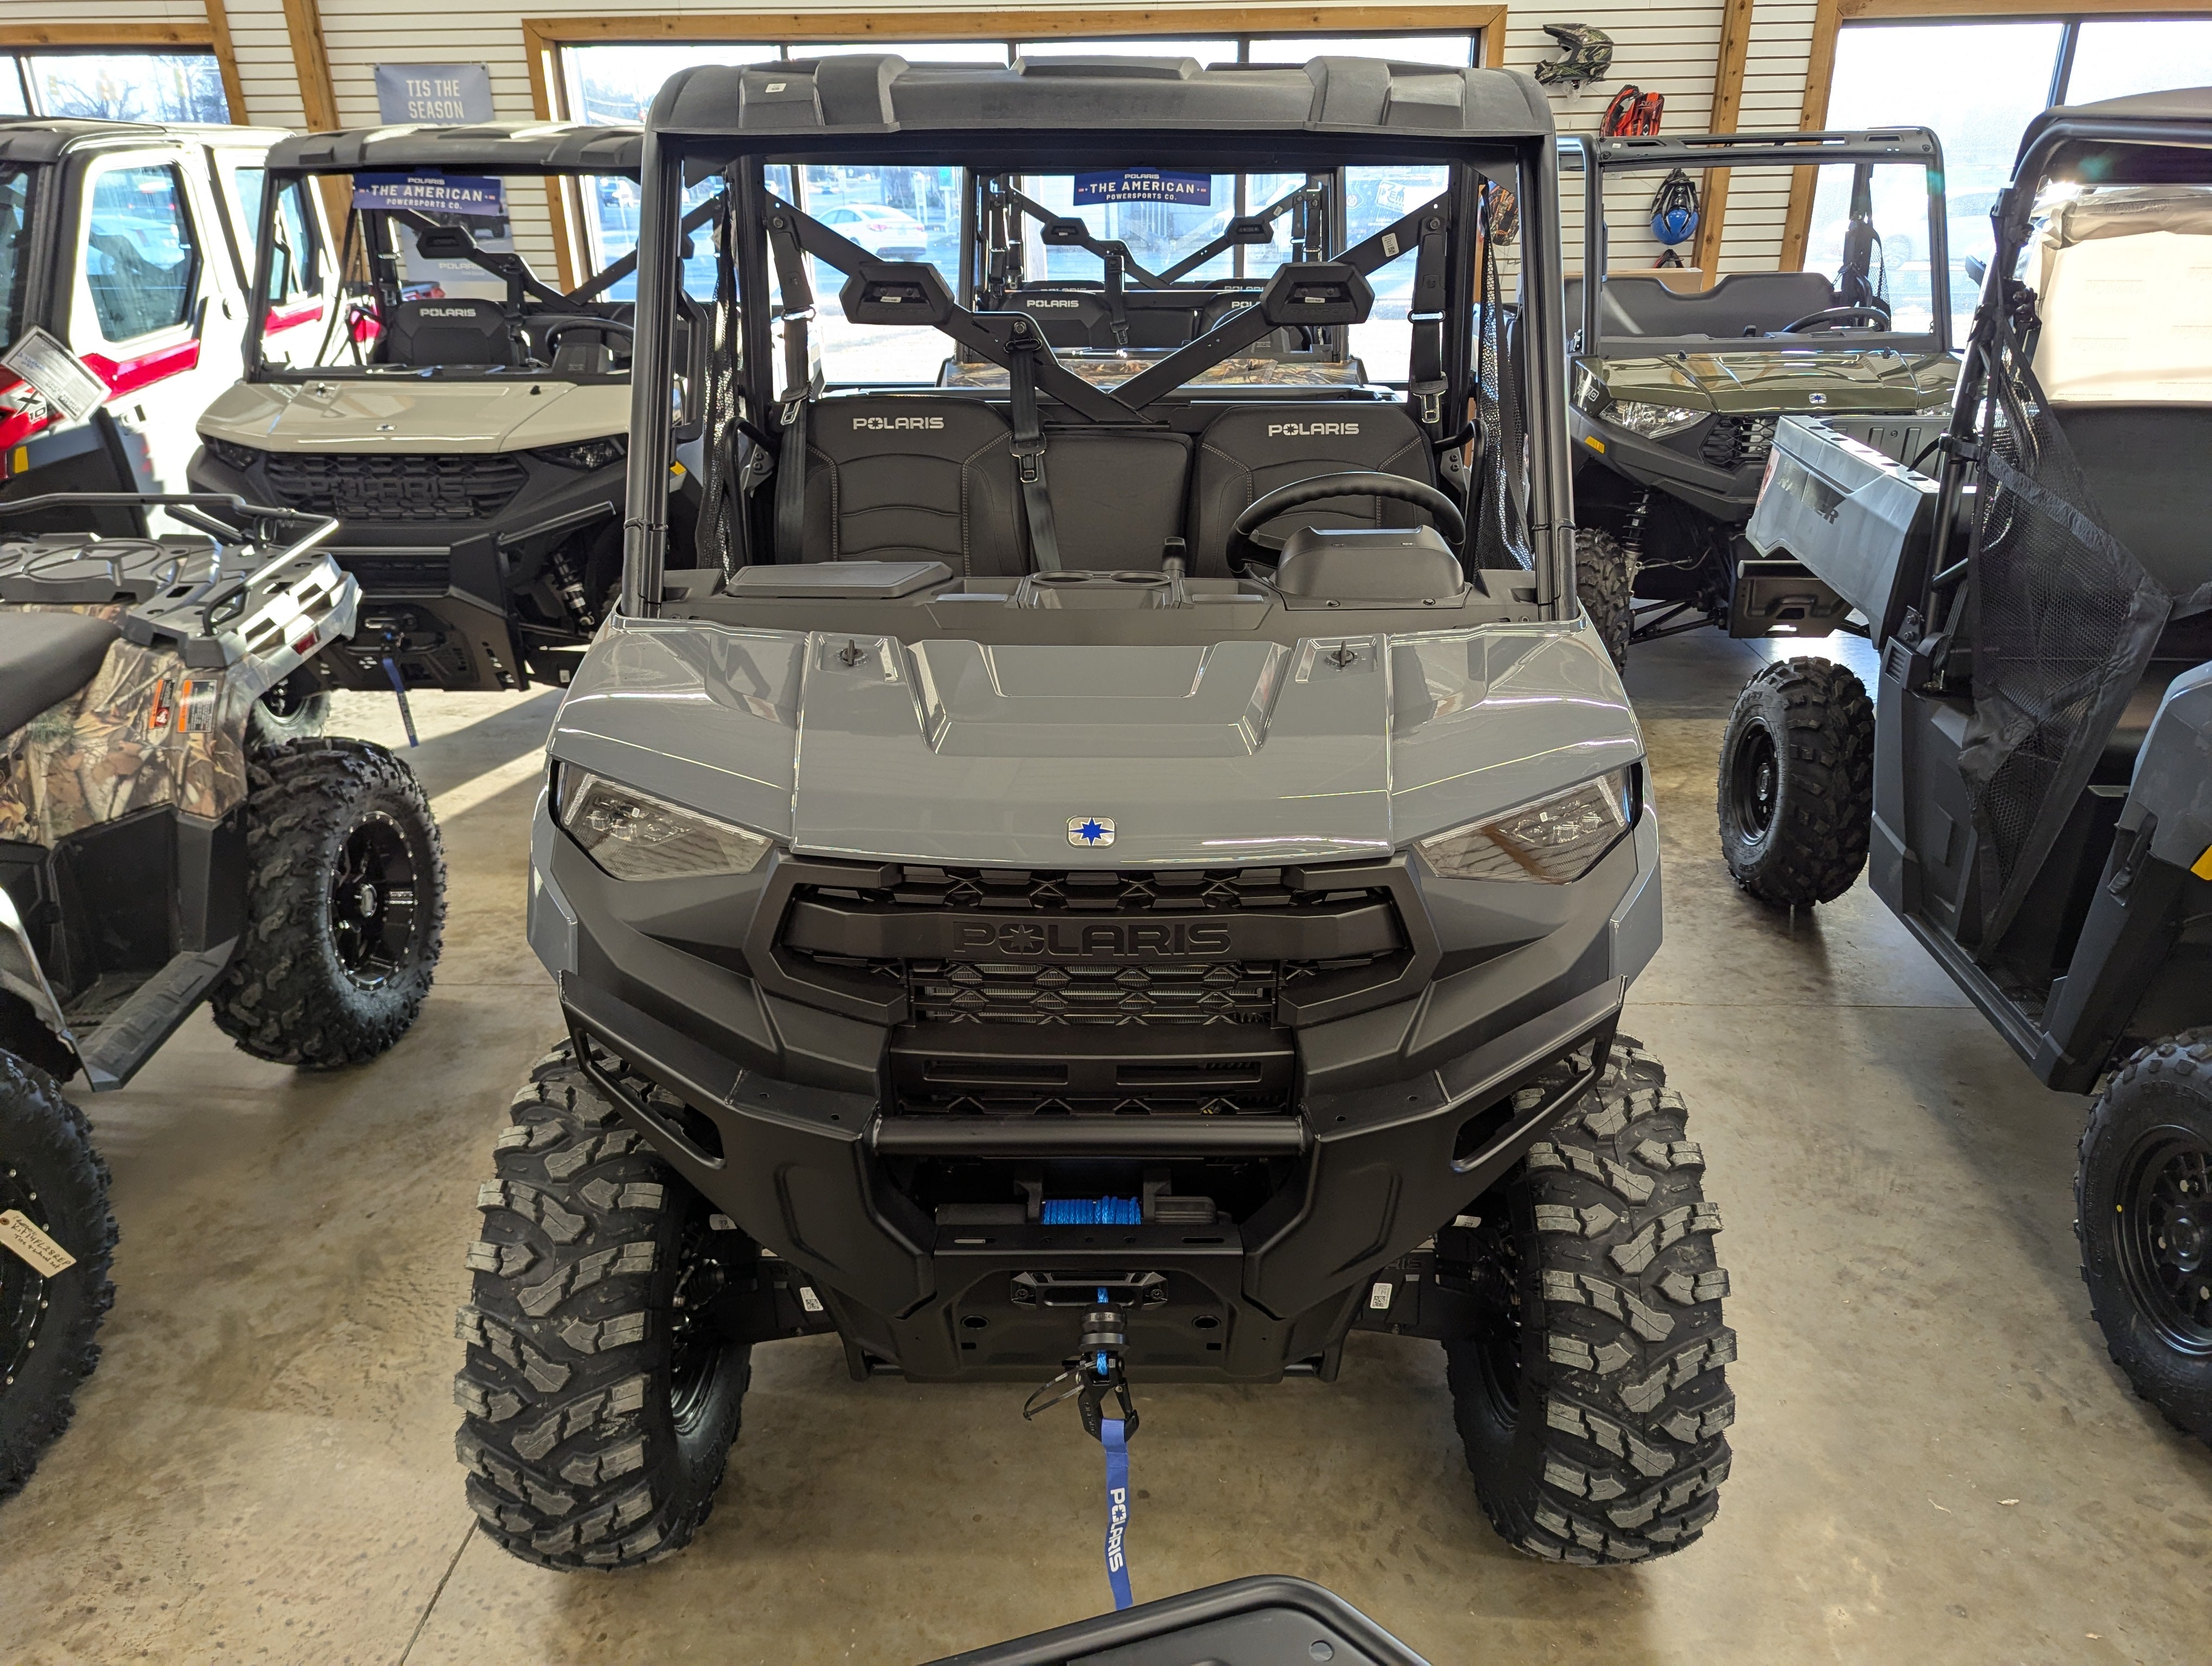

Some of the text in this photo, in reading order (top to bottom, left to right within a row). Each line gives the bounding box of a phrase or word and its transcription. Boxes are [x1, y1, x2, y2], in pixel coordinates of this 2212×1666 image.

[407, 79, 460, 97] TIS THE
[408, 101, 464, 119] SEASON
[371, 185, 482, 202] THE AMERICAN
[1090, 181, 1194, 194] THE AMERICAN
[386, 198, 446, 208] POWERSPORTS
[1026, 299, 1079, 307] POLARIS
[420, 308, 476, 317] POLARIS
[853, 417, 944, 430] POLARIS
[1268, 422, 1360, 437] POLARIS
[954, 921, 1232, 957] POLARIS
[1108, 1487, 1127, 1572] POLARIS
